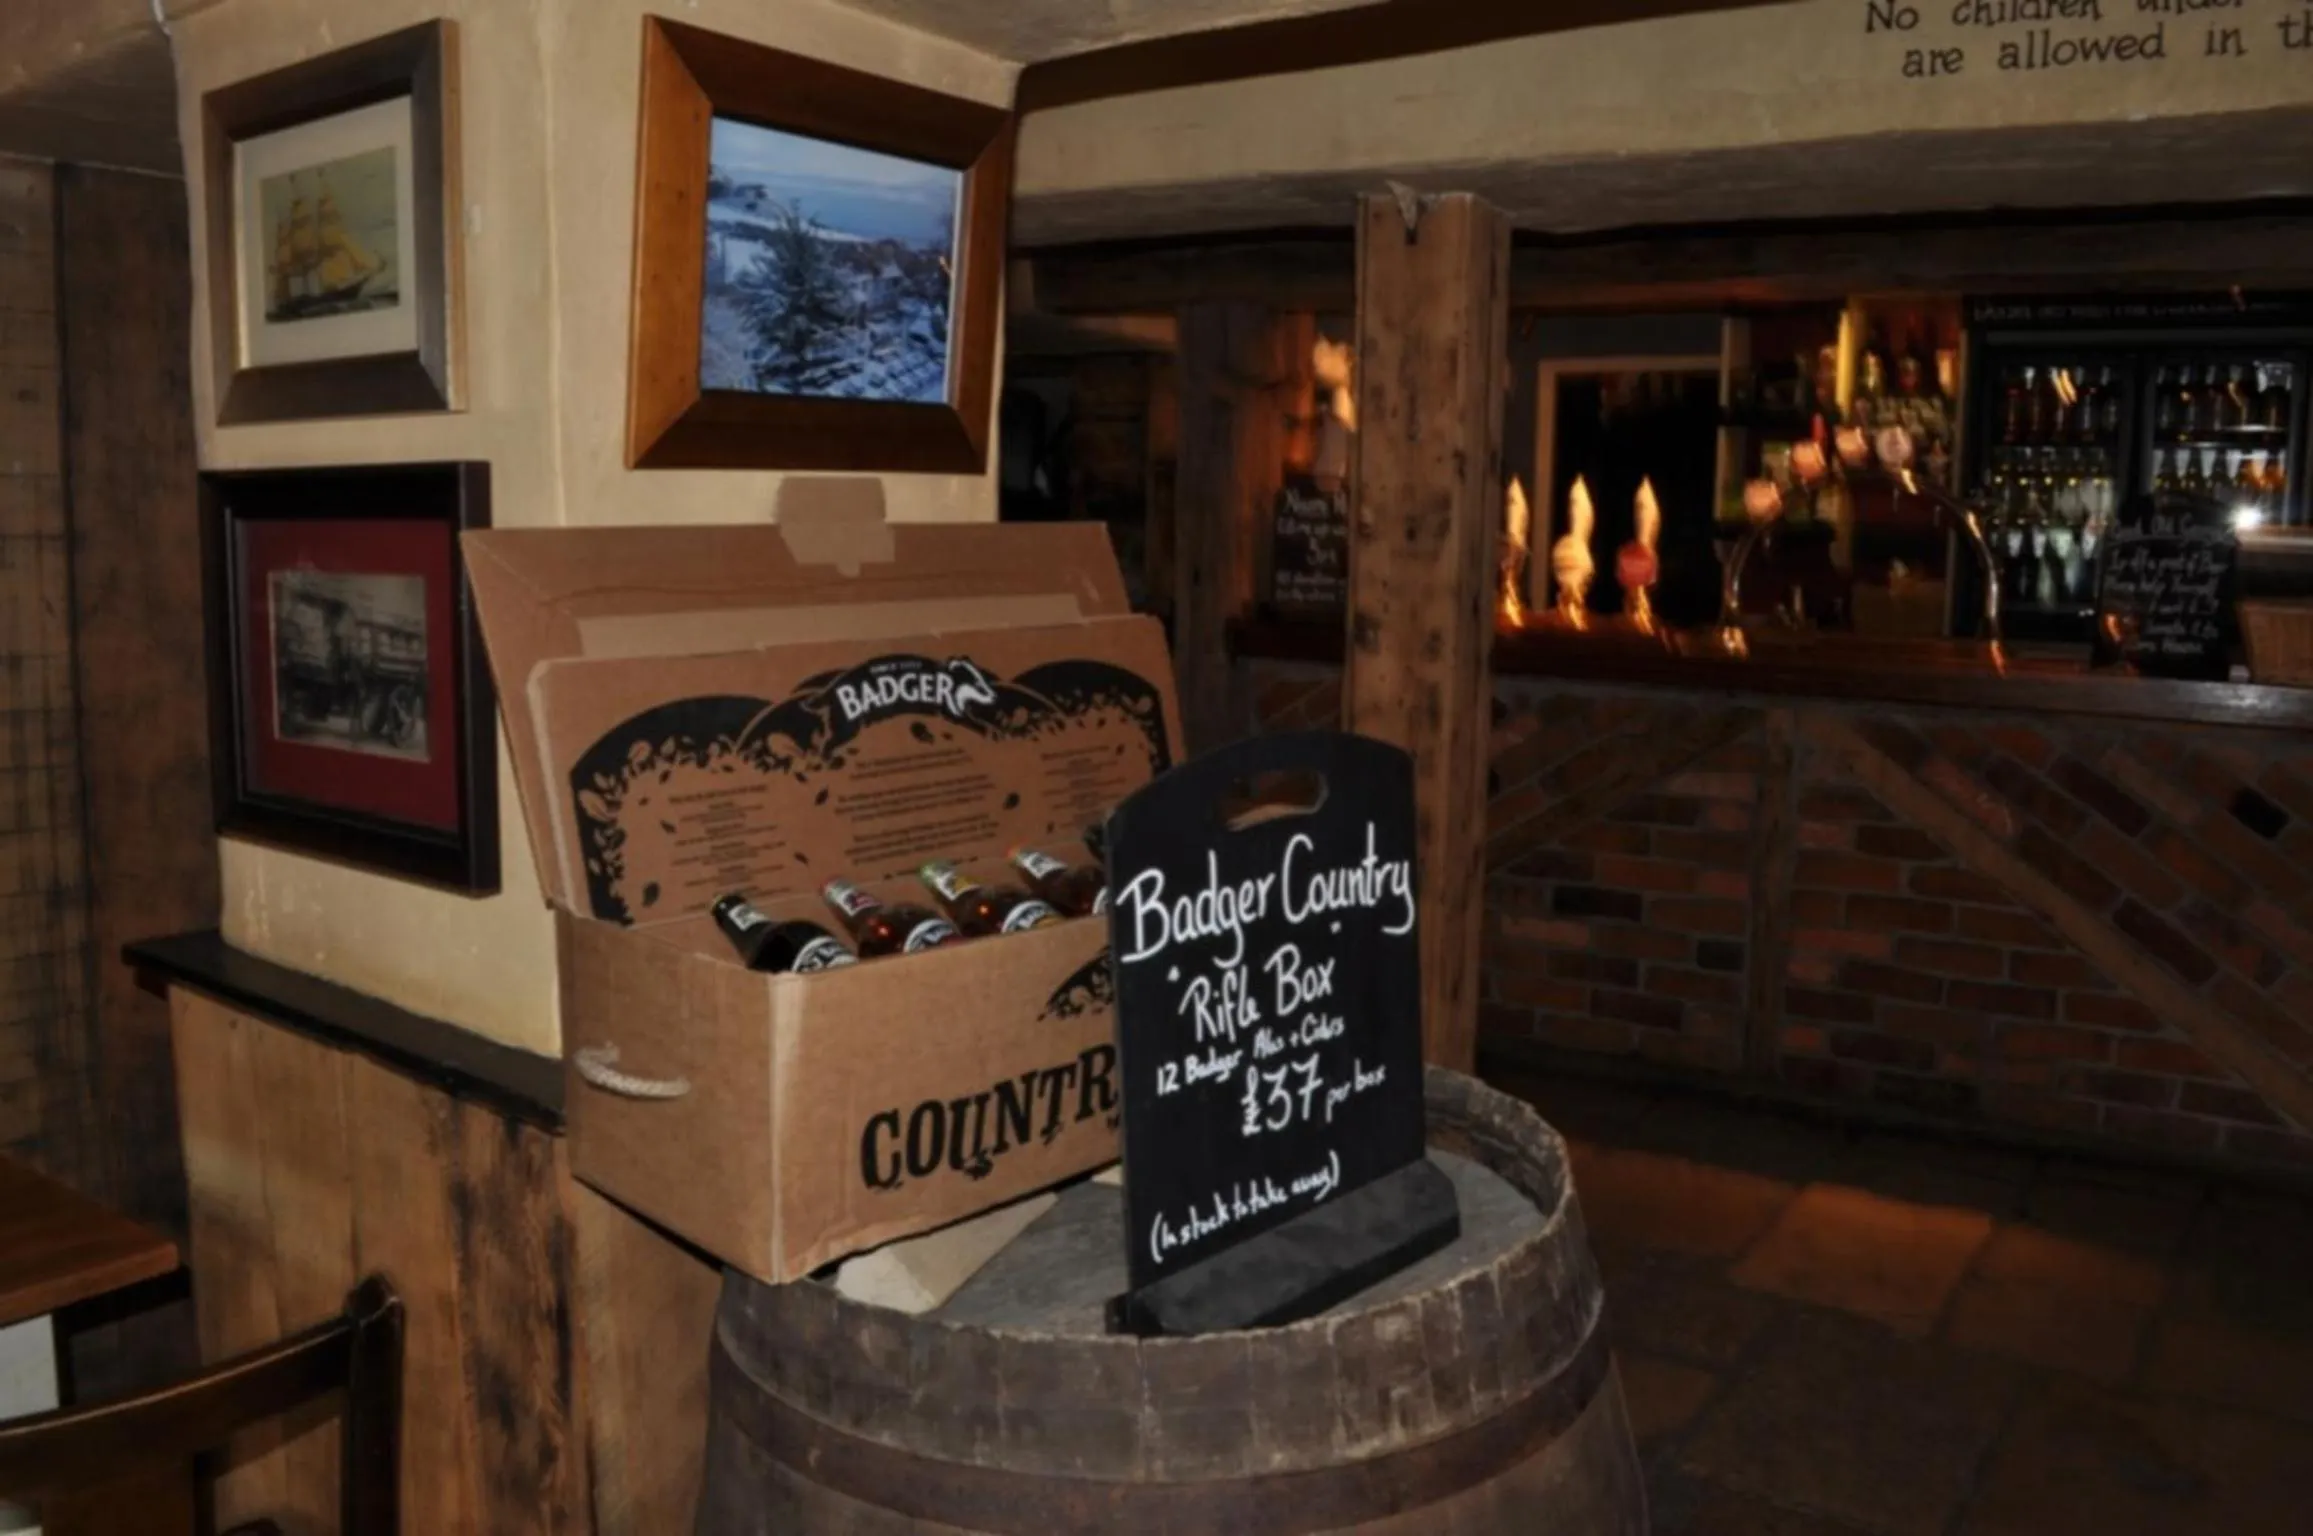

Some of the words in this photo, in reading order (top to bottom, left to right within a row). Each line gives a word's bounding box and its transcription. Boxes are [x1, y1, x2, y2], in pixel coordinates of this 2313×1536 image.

[1865, 1, 1919, 33] No
[1902, 47, 1964, 78] are
[1997, 22, 2167, 71] allowed
[2204, 20, 2249, 57] in
[836, 671, 962, 721] BADGER
[1116, 848, 1276, 969] Badger
[1281, 820, 1415, 935] Country
[1176, 963, 1261, 1043] Rifle
[1262, 942, 1336, 1017] Box
[1157, 1061, 1180, 1096] 12
[1185, 1046, 1244, 1085] Badger
[1241, 1052, 1324, 1136] £37
[1325, 1080, 1352, 1124] per
[1354, 1057, 1387, 1092] box
[1180, 1192, 1230, 1246] stock
[1232, 1181, 1248, 1221] to
[1249, 1176, 1288, 1215] take
